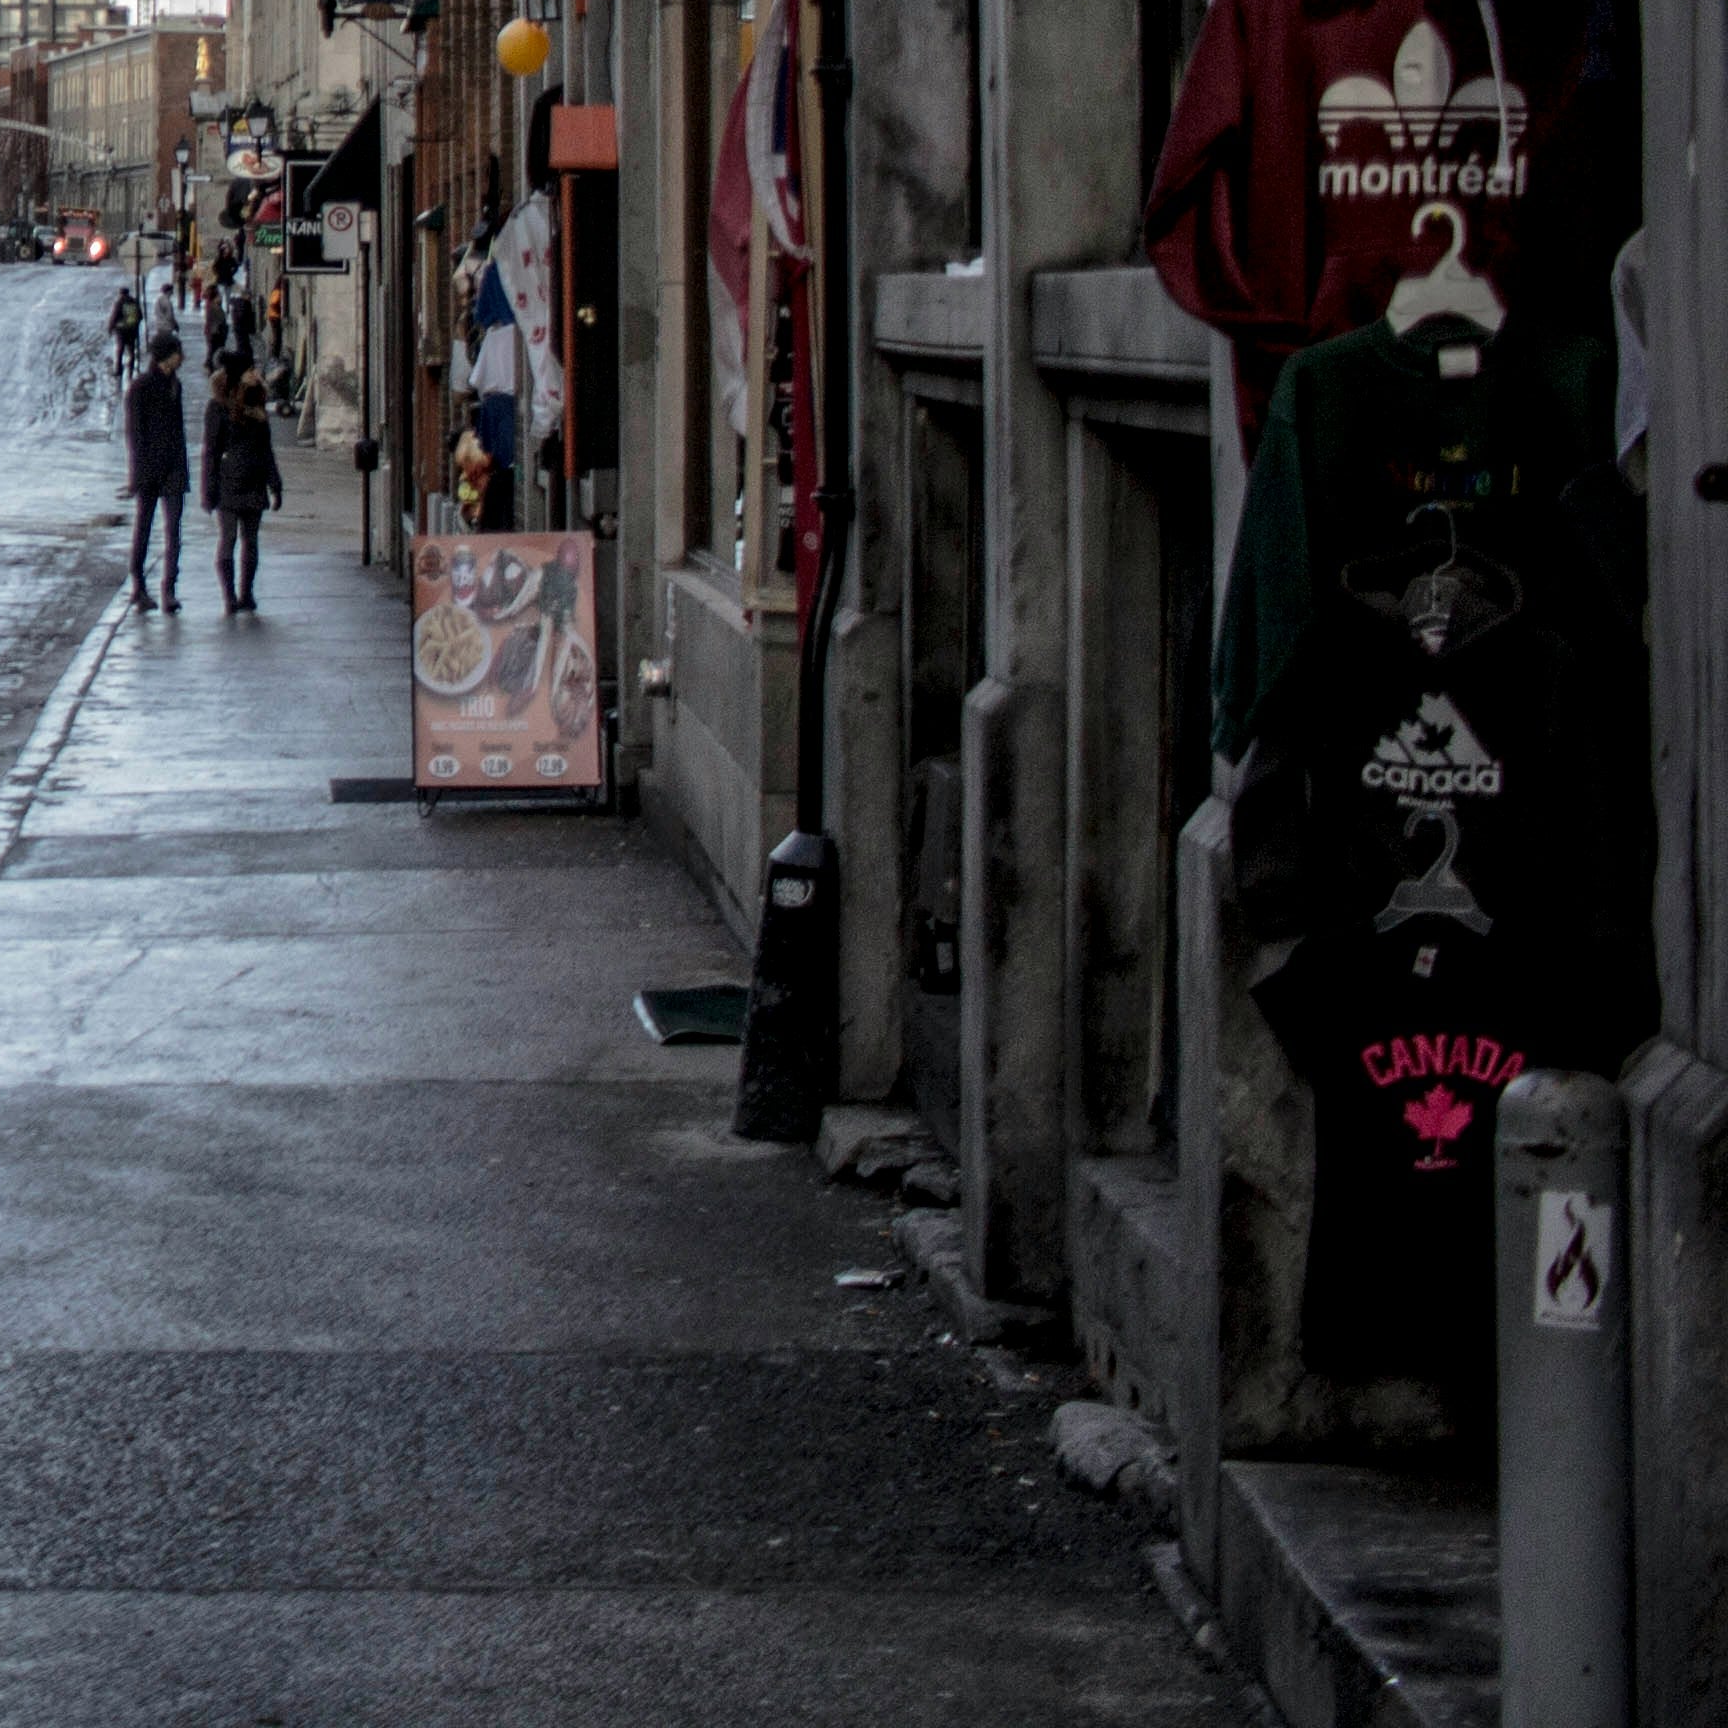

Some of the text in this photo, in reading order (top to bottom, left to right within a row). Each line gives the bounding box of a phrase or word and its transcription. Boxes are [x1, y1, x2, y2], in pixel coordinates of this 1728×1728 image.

[1317, 154, 1528, 198] montréal
[1361, 757, 1505, 797] canada
[1360, 1032, 1529, 1089] CANADA
